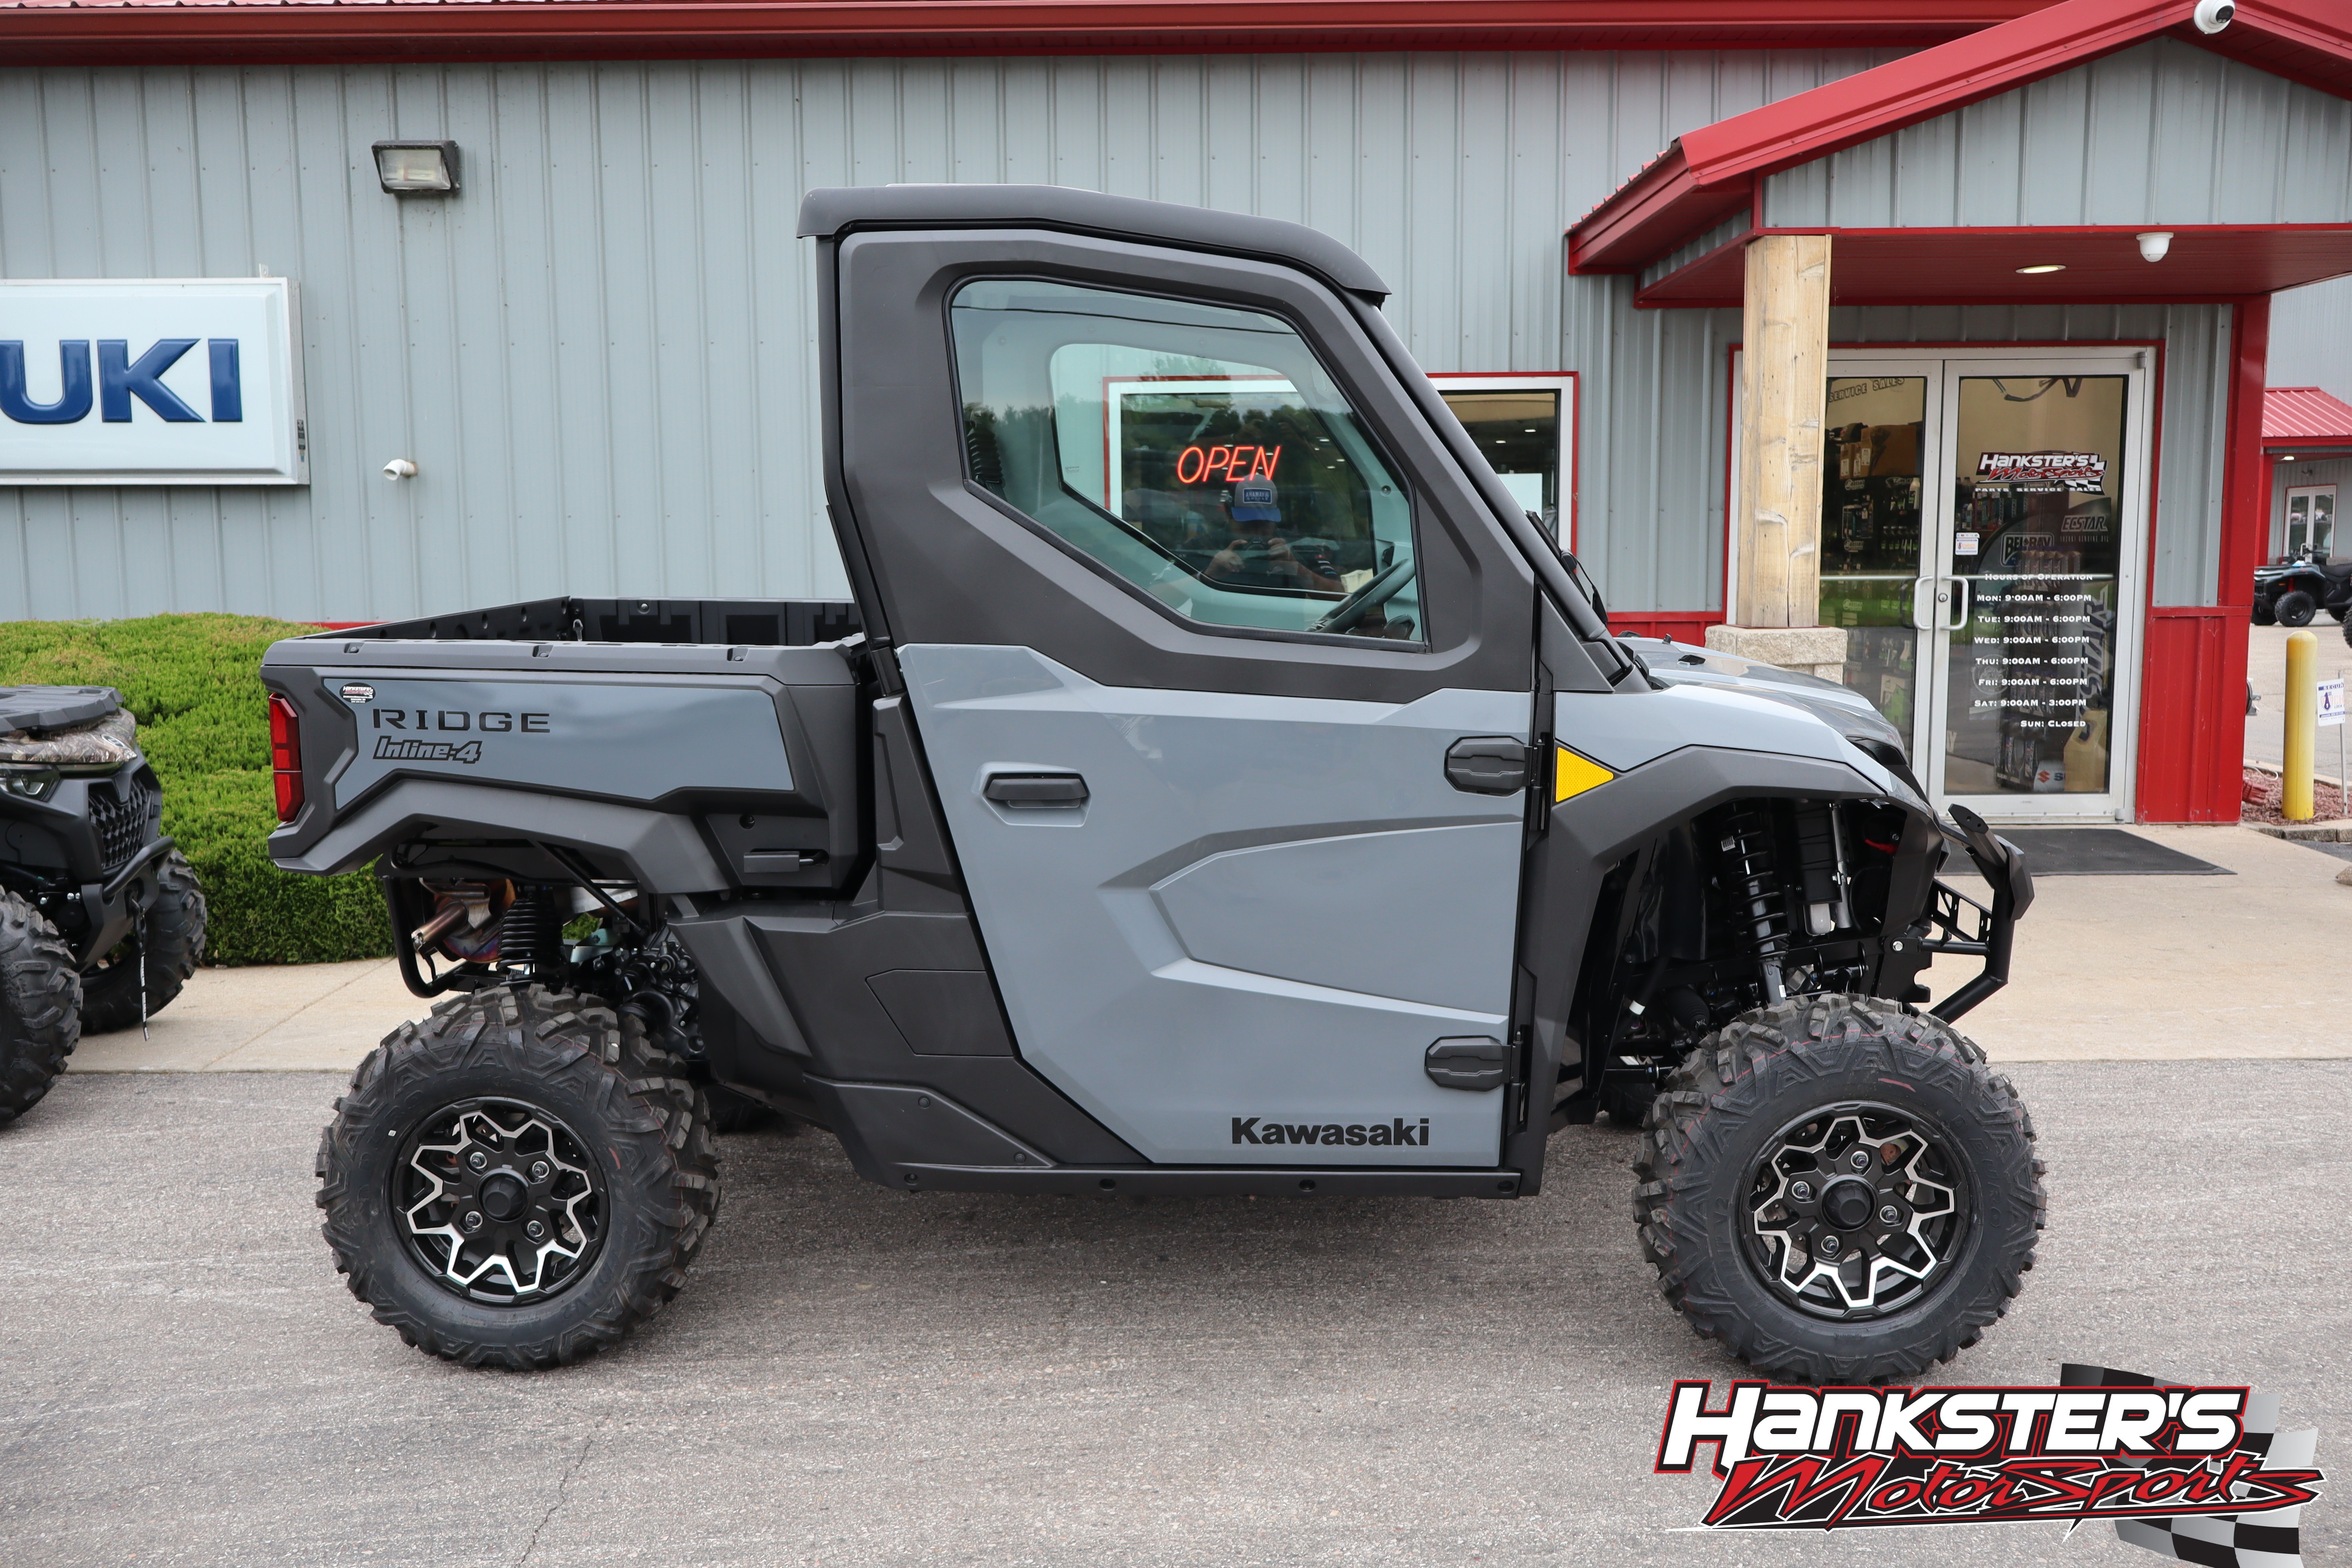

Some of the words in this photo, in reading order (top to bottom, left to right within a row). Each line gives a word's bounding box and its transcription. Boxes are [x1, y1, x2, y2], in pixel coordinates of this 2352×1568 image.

[0, 338, 242, 424] UKI
[1828, 383, 1867, 402] SERVICE
[1873, 377, 1905, 391] SALES
[1177, 445, 1281, 483] OPEN
[2061, 515, 2108, 532] ECSTAR
[373, 708, 550, 733] RIDGE
[373, 735, 483, 764] Inline-4
[1232, 1117, 1429, 1146] Kawasaki
[1968, 1138, 2002, 1228] DURO
